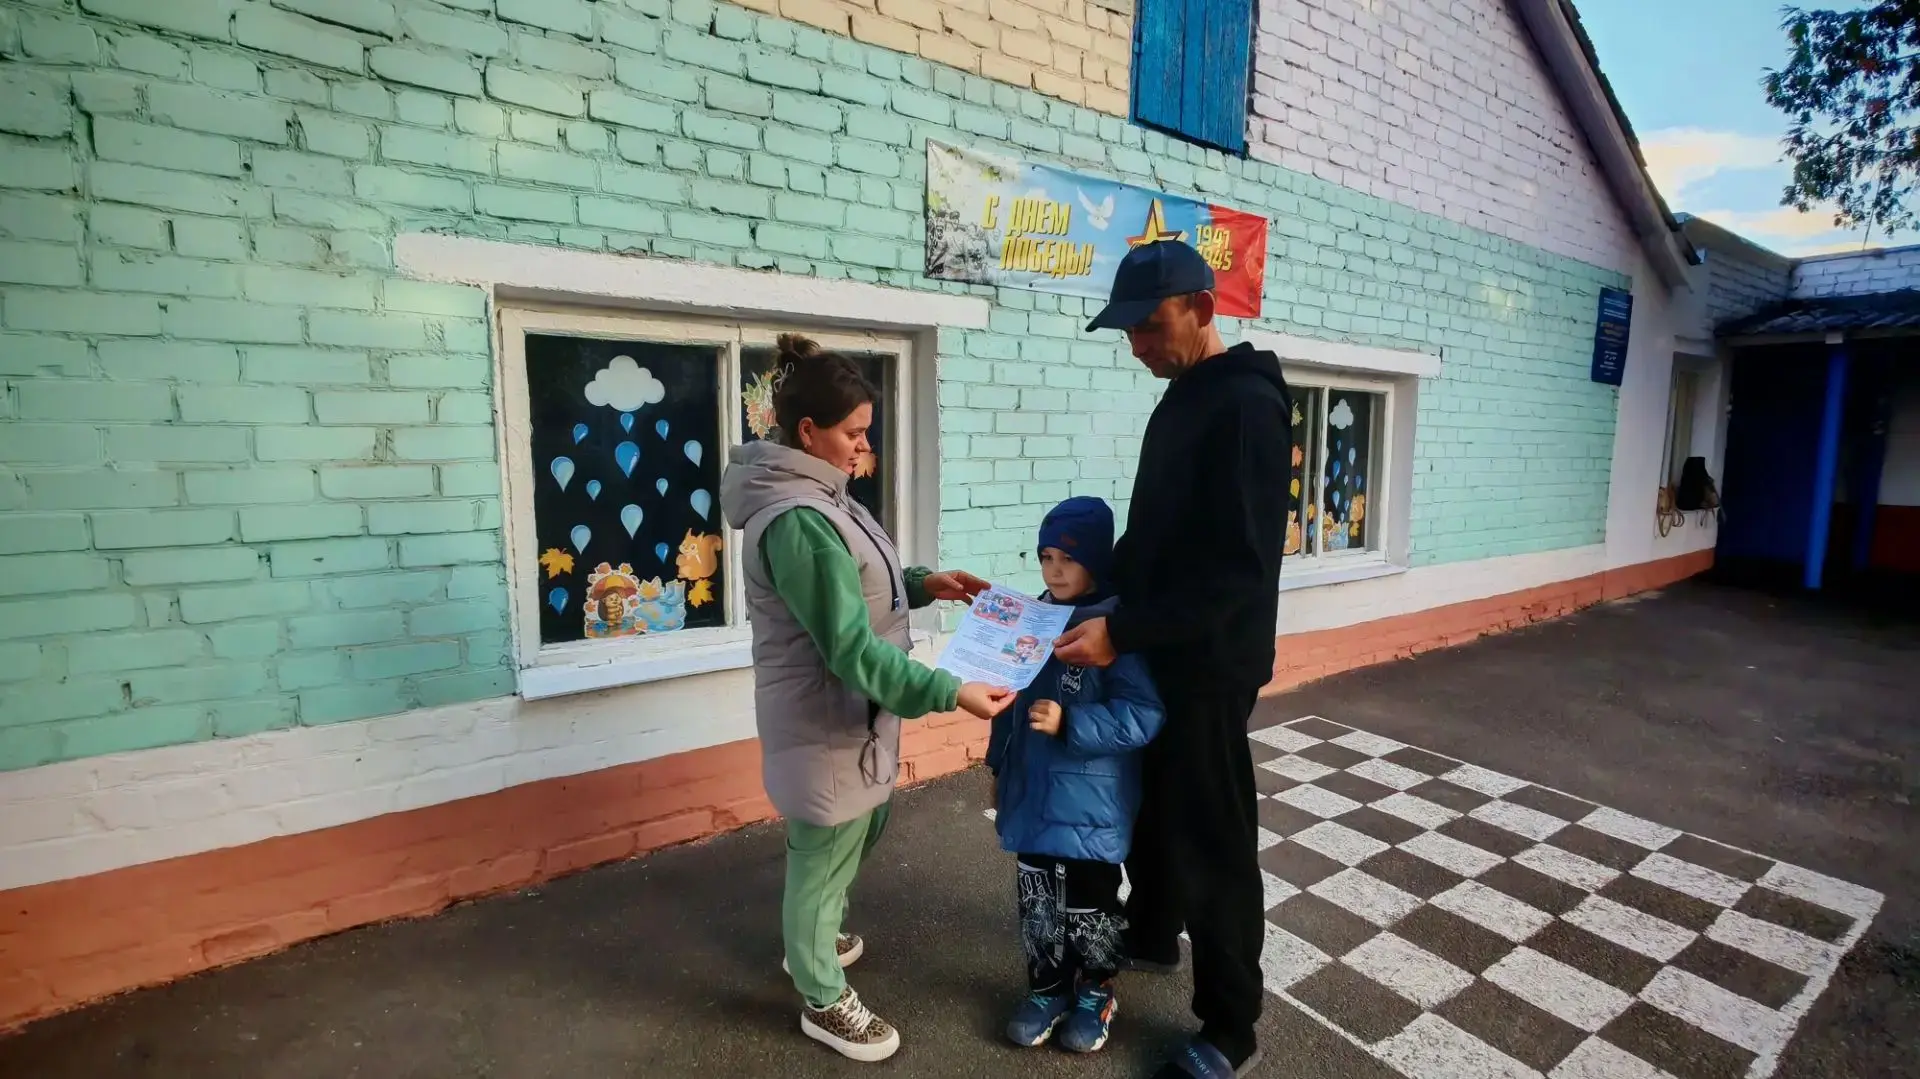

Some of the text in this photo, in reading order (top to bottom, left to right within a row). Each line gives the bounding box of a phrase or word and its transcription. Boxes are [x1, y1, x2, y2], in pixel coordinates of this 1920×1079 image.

[983, 193, 1071, 237] С ДНЕМ
[1195, 223, 1231, 250] 1941
[1000, 236, 1094, 279] ПОБЕДЫ!
